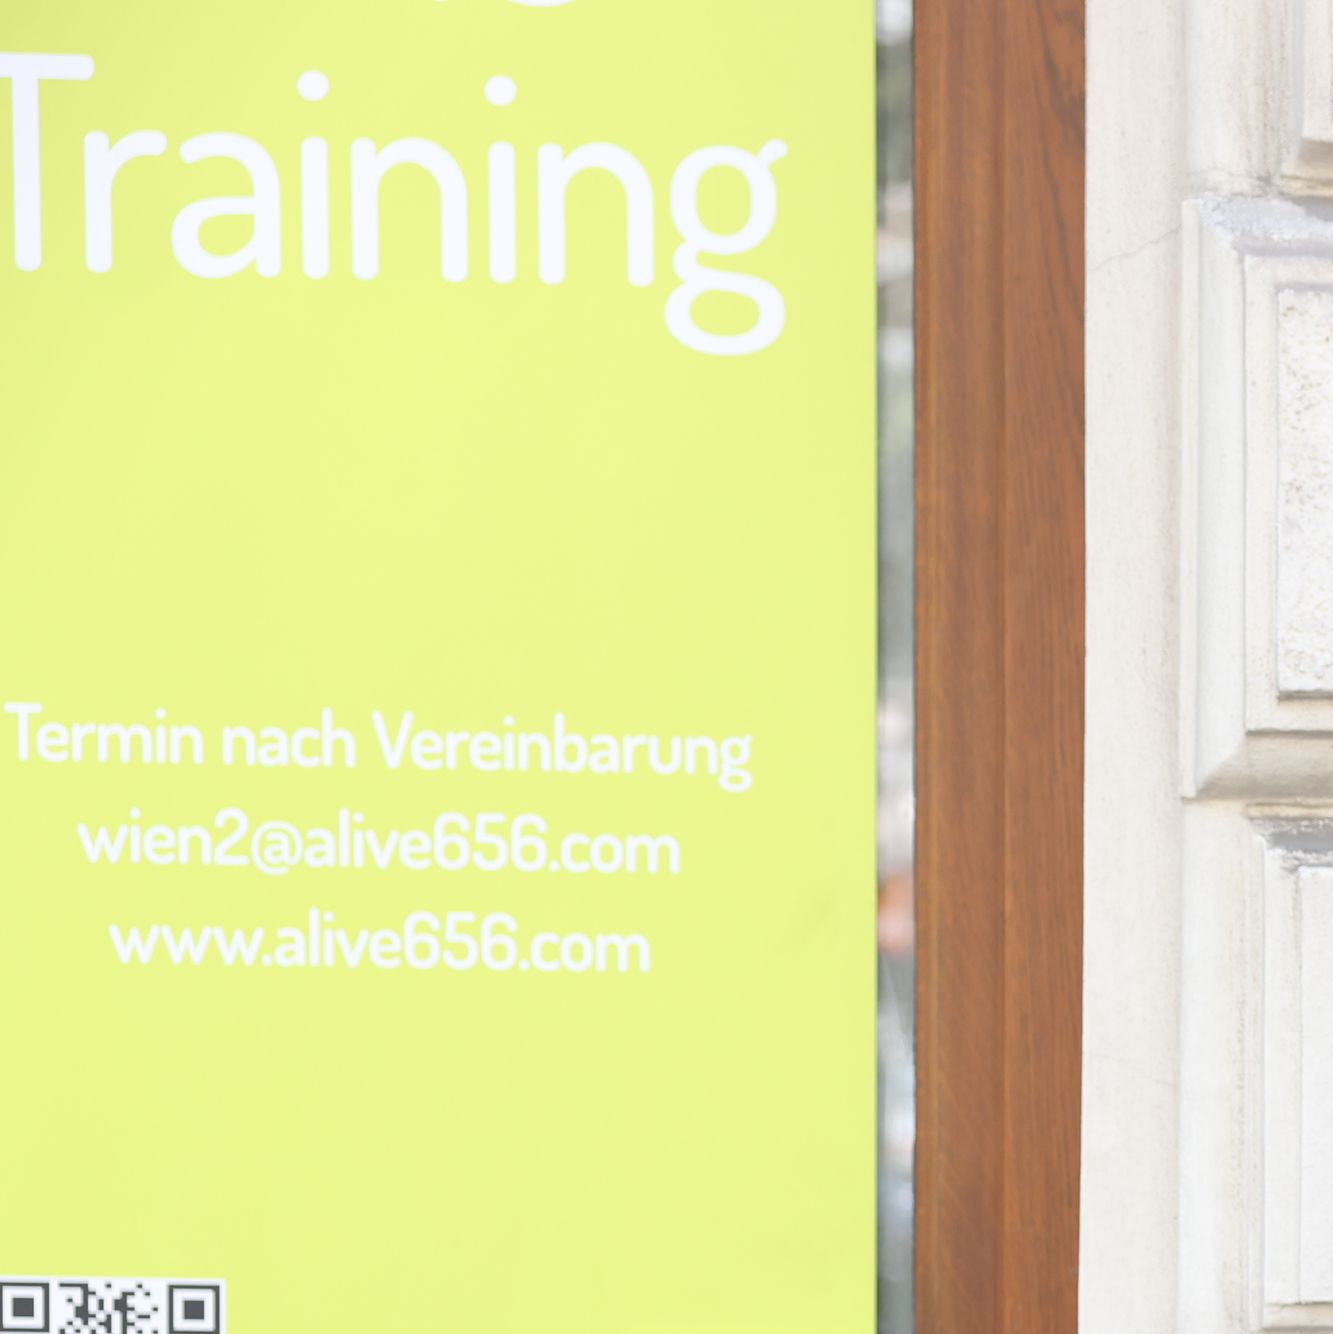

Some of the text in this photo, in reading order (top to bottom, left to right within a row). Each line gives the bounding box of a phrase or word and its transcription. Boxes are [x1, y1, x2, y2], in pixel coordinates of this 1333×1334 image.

[0, 51, 788, 356] Training
[4, 702, 753, 792] Termin nach Vereinbarung
[77, 807, 681, 875] wien2@alive656.com
[108, 907, 651, 973] www.alive656.com
